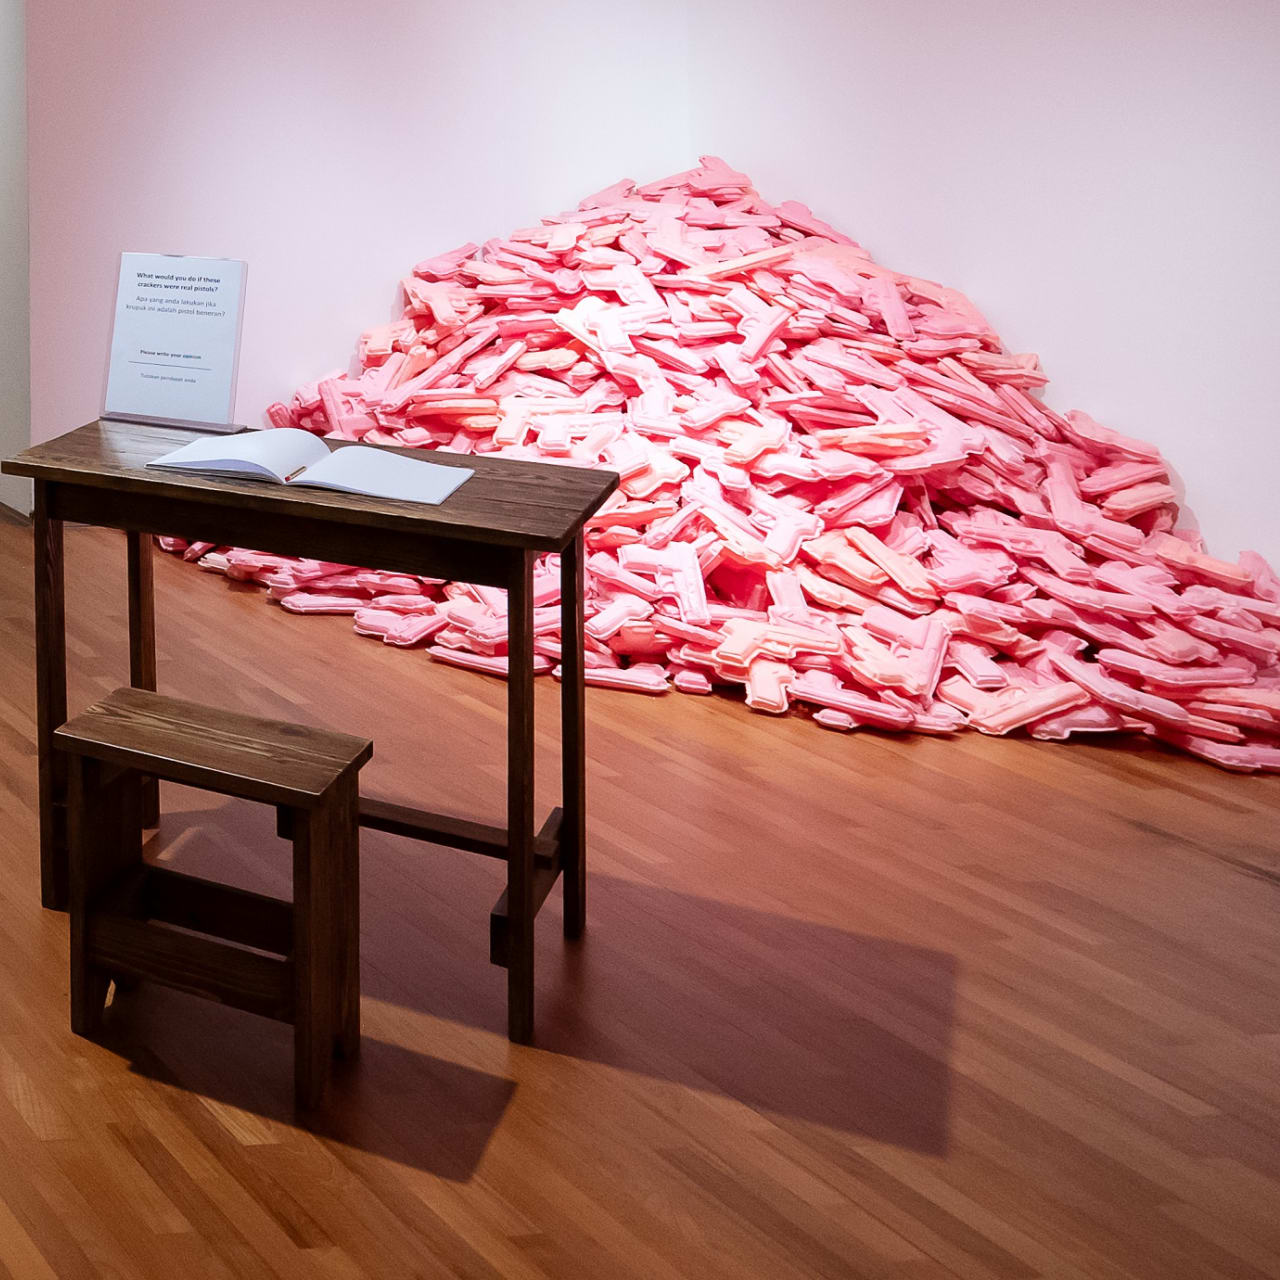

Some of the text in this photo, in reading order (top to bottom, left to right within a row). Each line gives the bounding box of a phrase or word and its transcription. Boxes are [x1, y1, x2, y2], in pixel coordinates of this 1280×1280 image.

[175, 274, 186, 282] you
[194, 285, 218, 293] pistols?
[149, 296, 164, 304] yang
[205, 300, 216, 308] jika
